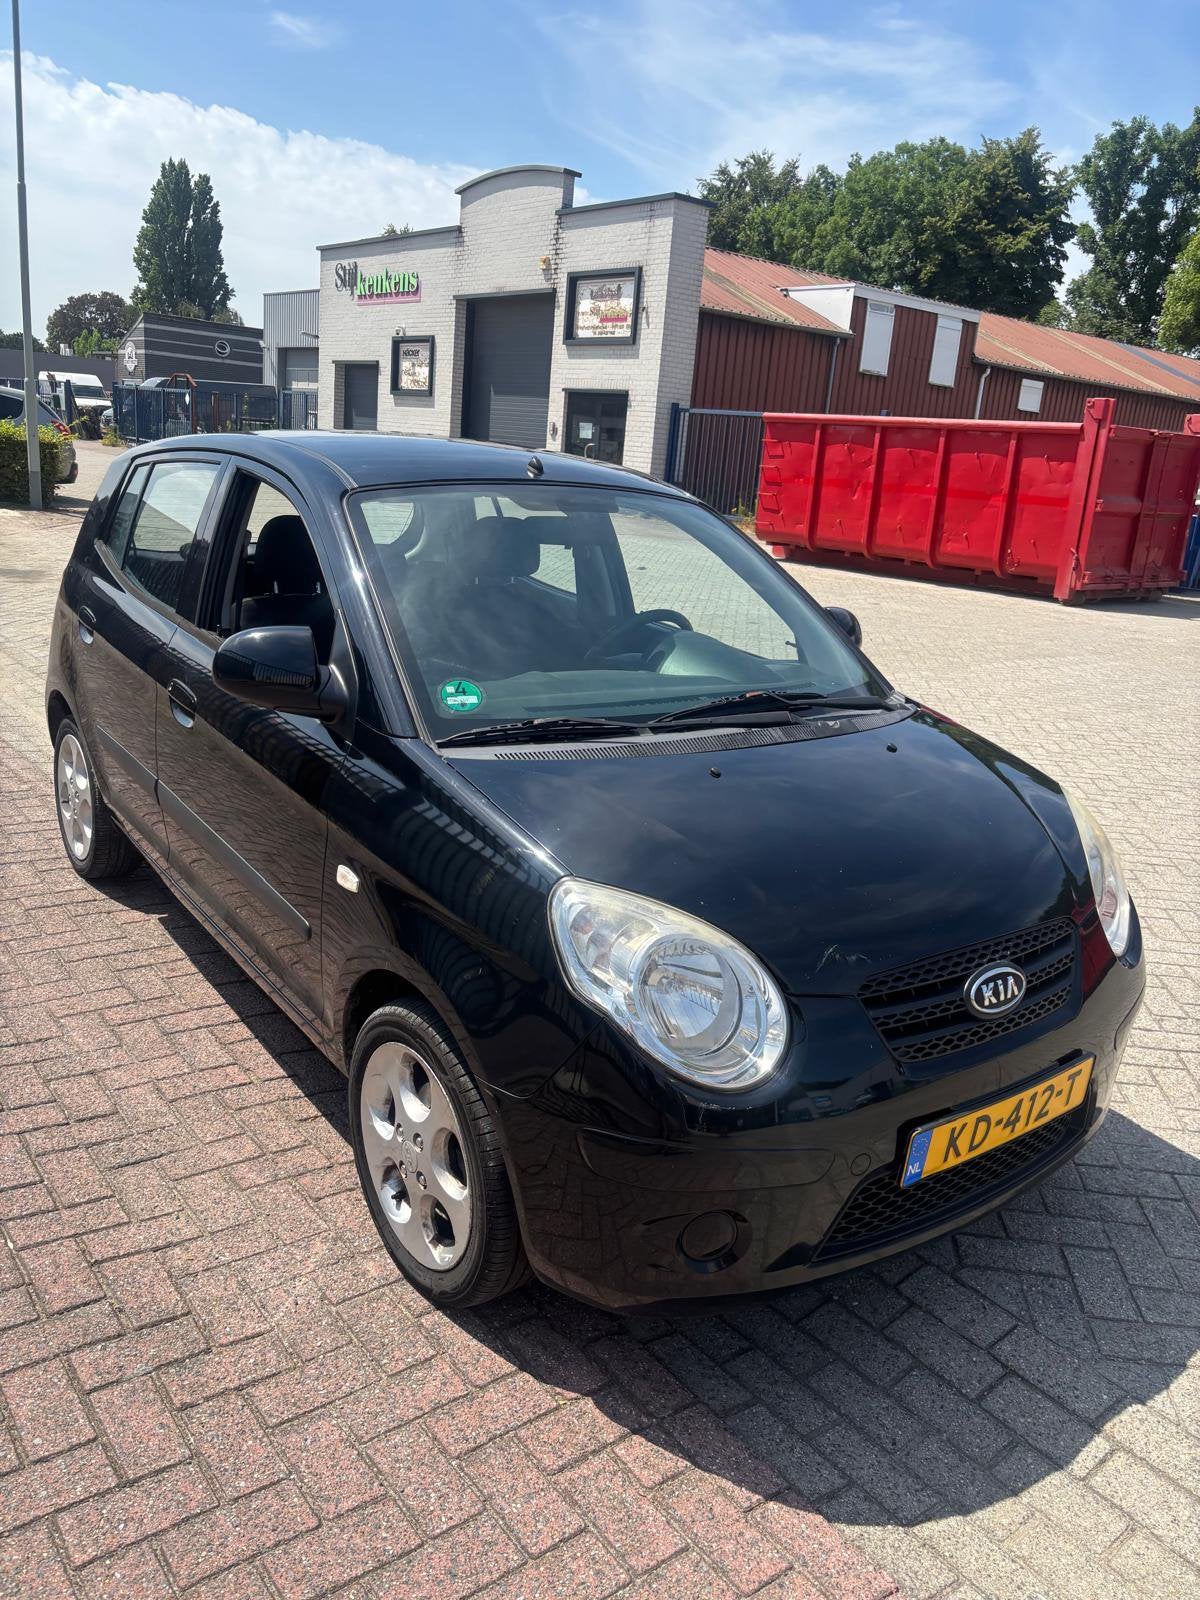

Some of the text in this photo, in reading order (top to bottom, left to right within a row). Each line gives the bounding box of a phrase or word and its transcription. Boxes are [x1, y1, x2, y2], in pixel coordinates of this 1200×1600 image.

[356, 267, 419, 296] keukens
[454, 681, 467, 696] 4
[981, 976, 1019, 1006] KIA
[943, 1068, 1083, 1163] KD-412-T
[907, 1161, 921, 1176] NL
